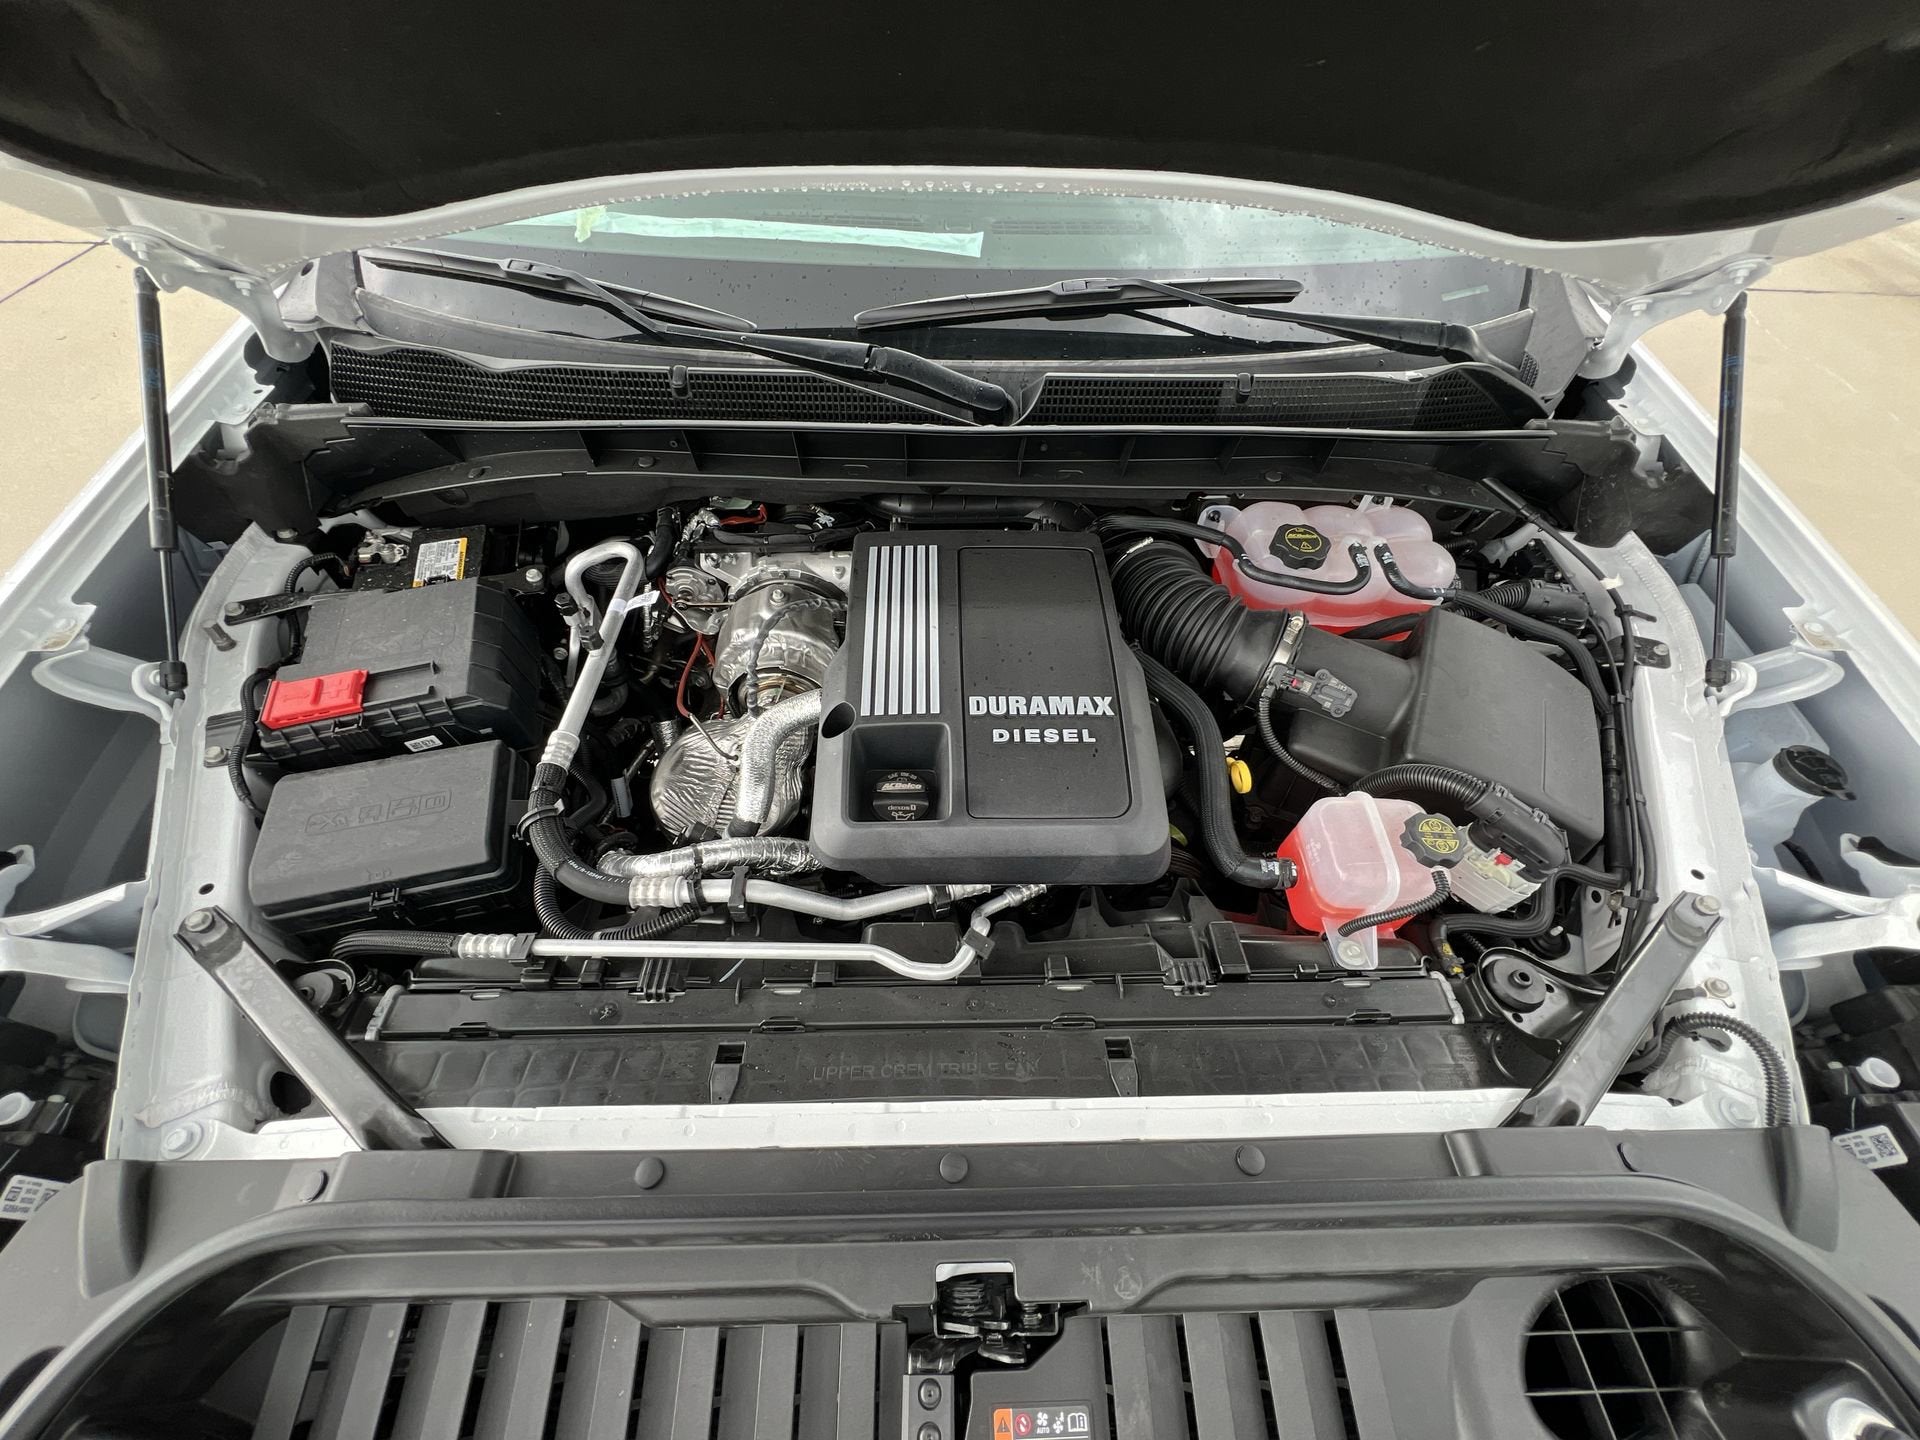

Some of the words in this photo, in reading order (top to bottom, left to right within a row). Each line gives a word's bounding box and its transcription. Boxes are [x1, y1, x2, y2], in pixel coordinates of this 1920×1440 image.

[968, 696, 1115, 716] DURAMAX
[992, 728, 1097, 743] DIESEL
[881, 782, 922, 791] ACDelco
[813, 1064, 876, 1081] UPPER
